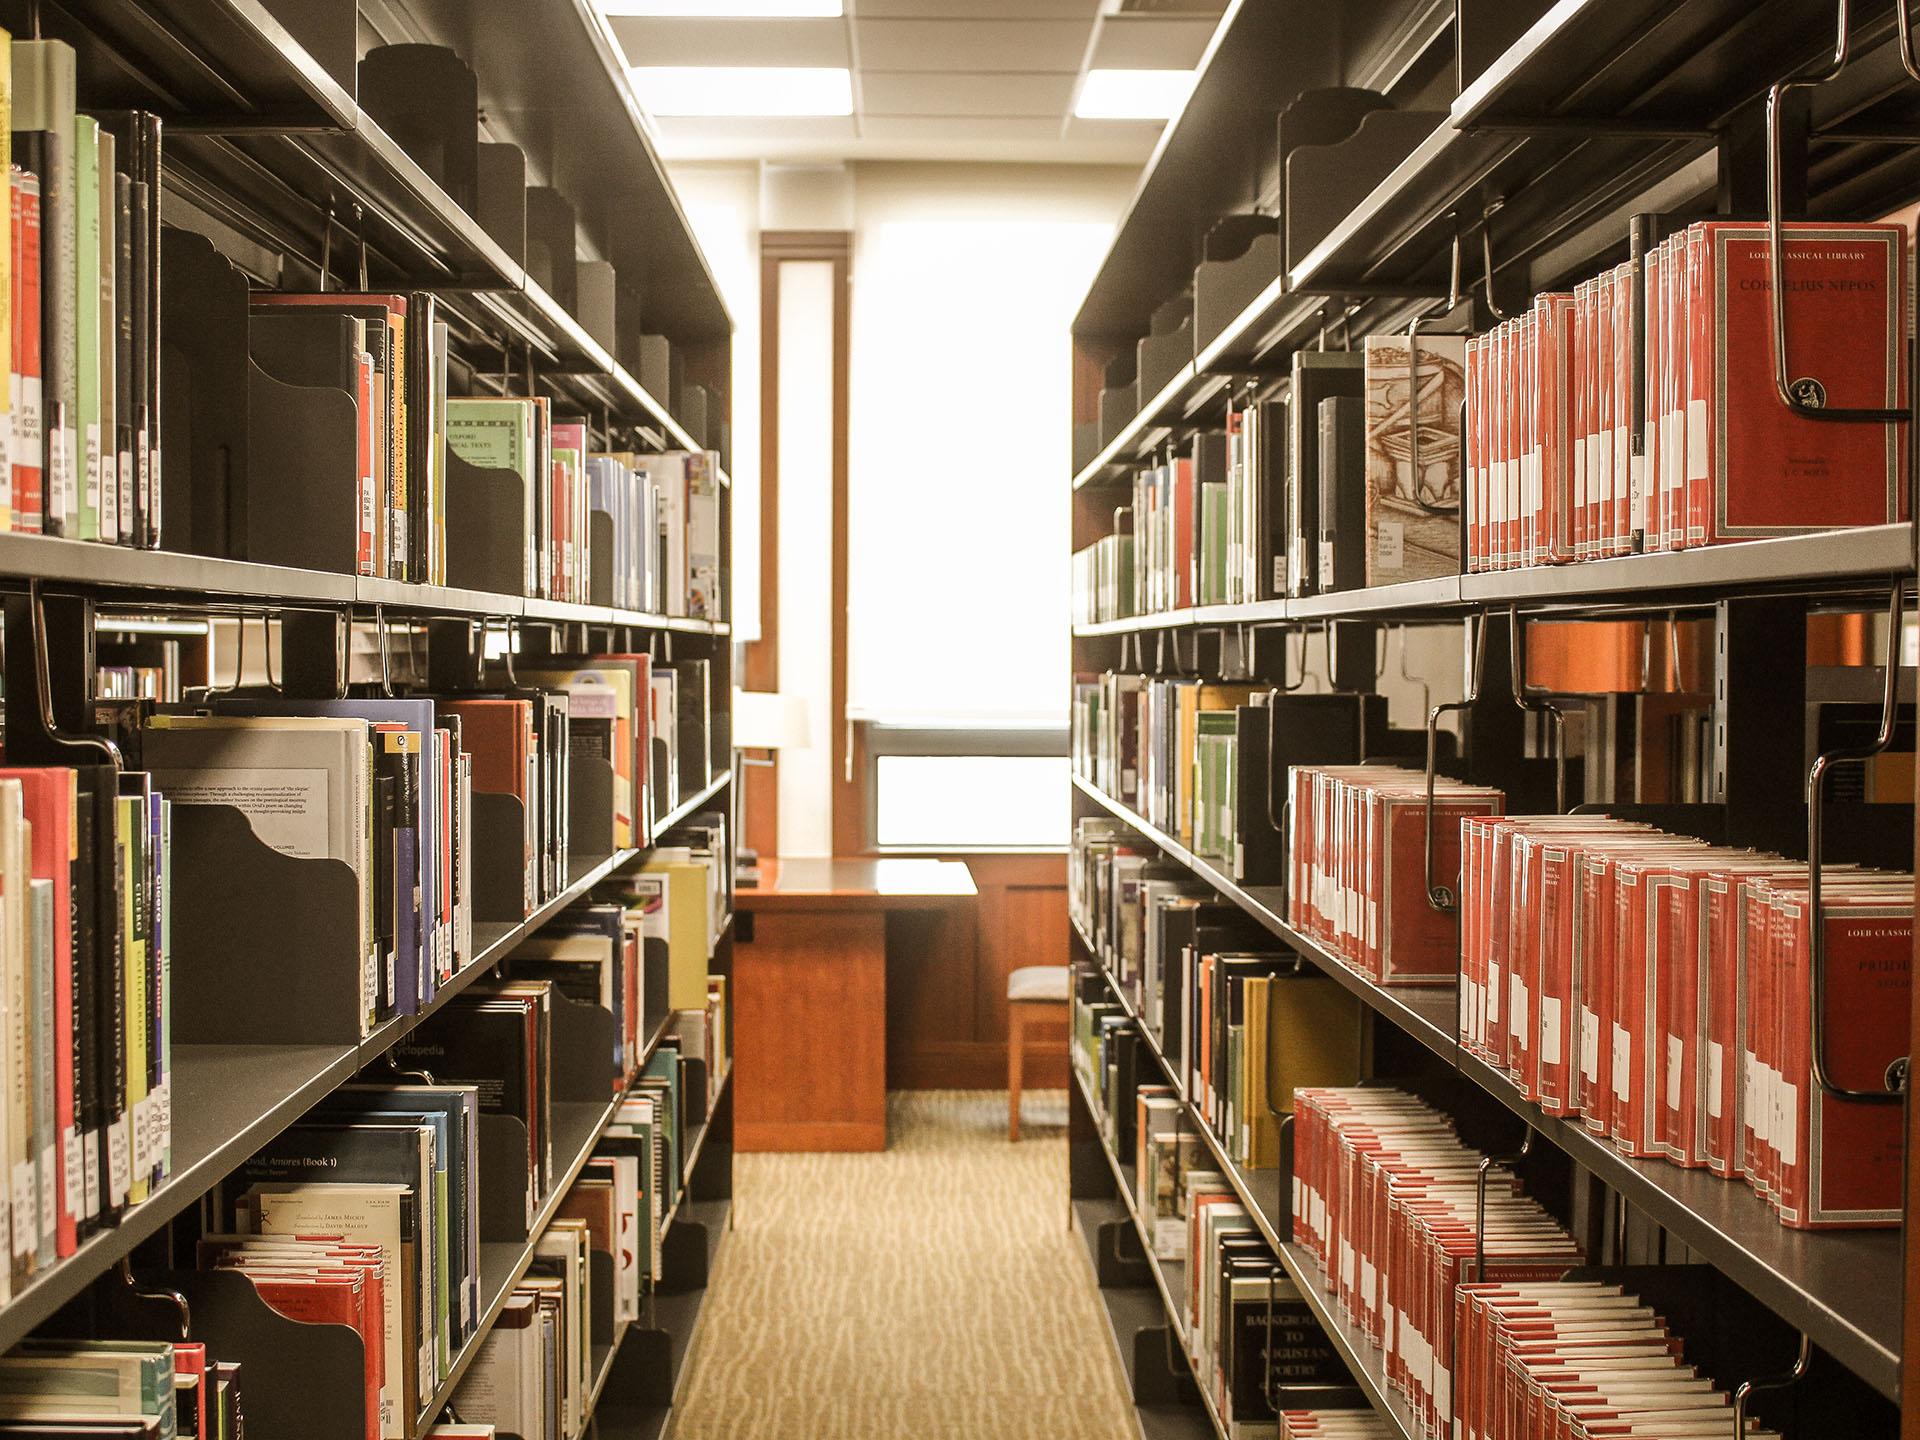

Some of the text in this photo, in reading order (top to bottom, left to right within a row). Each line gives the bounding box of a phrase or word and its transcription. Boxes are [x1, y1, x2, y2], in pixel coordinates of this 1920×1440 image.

[1826, 252, 1866, 260] LIBRARY
[1740, 279, 1876, 292] CORELIUS NEPOS
[1858, 960, 1910, 971] PRUDE
[392, 1044, 444, 1056] cyclopedia
[270, 1158, 300, 1166] Amores
[302, 1157, 328, 1167] (Book
[330, 1157, 337, 1168] 1)
[1246, 1316, 1318, 1326] BACKGROU
[1285, 1332, 1304, 1342] TO
[1271, 1365, 1317, 1376] POETRY
